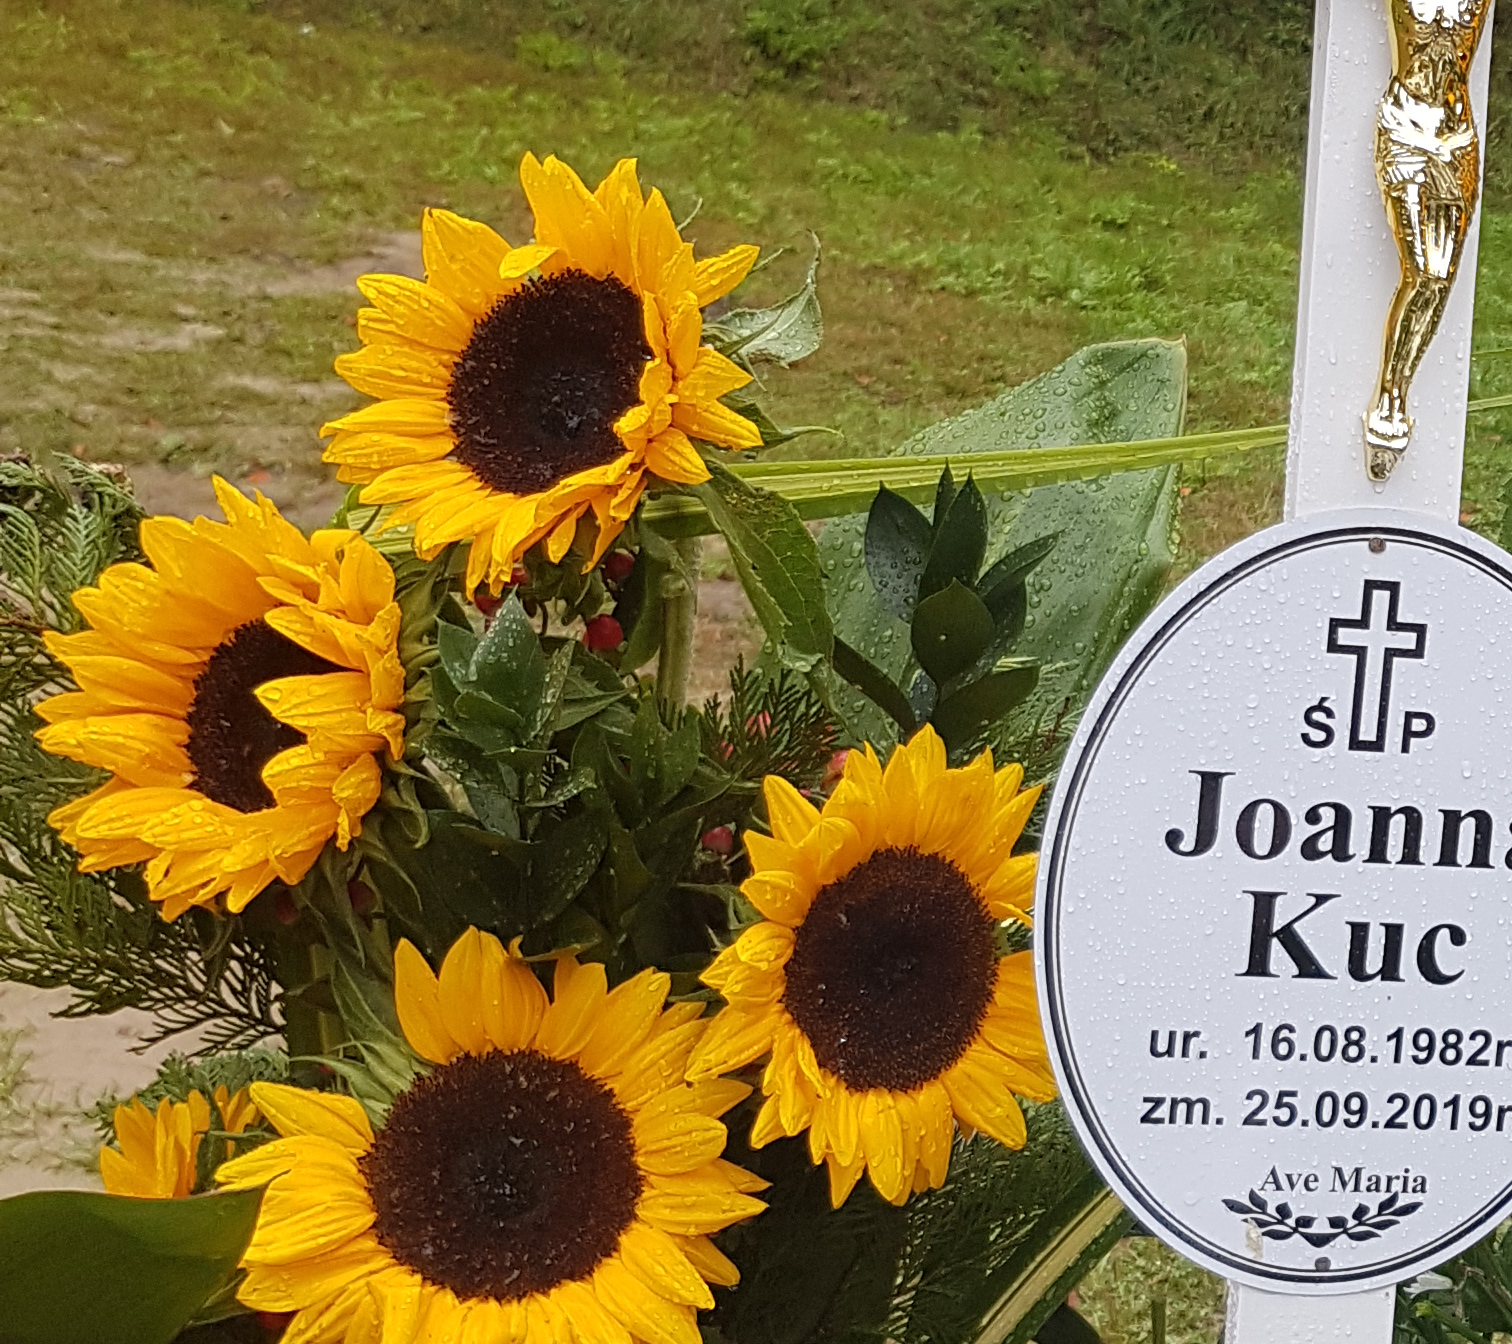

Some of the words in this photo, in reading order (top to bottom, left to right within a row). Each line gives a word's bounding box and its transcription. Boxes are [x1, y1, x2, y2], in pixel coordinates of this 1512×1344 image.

[1300, 696, 1336, 749] Ś
[1400, 710, 1436, 754] P
[1234, 890, 1468, 986] Kuc
[1149, 1029, 1208, 1060] ur.
[1139, 1096, 1224, 1126] zm.
[1258, 1165, 1319, 1193] Ave
[1329, 1166, 1428, 1194] Maria
